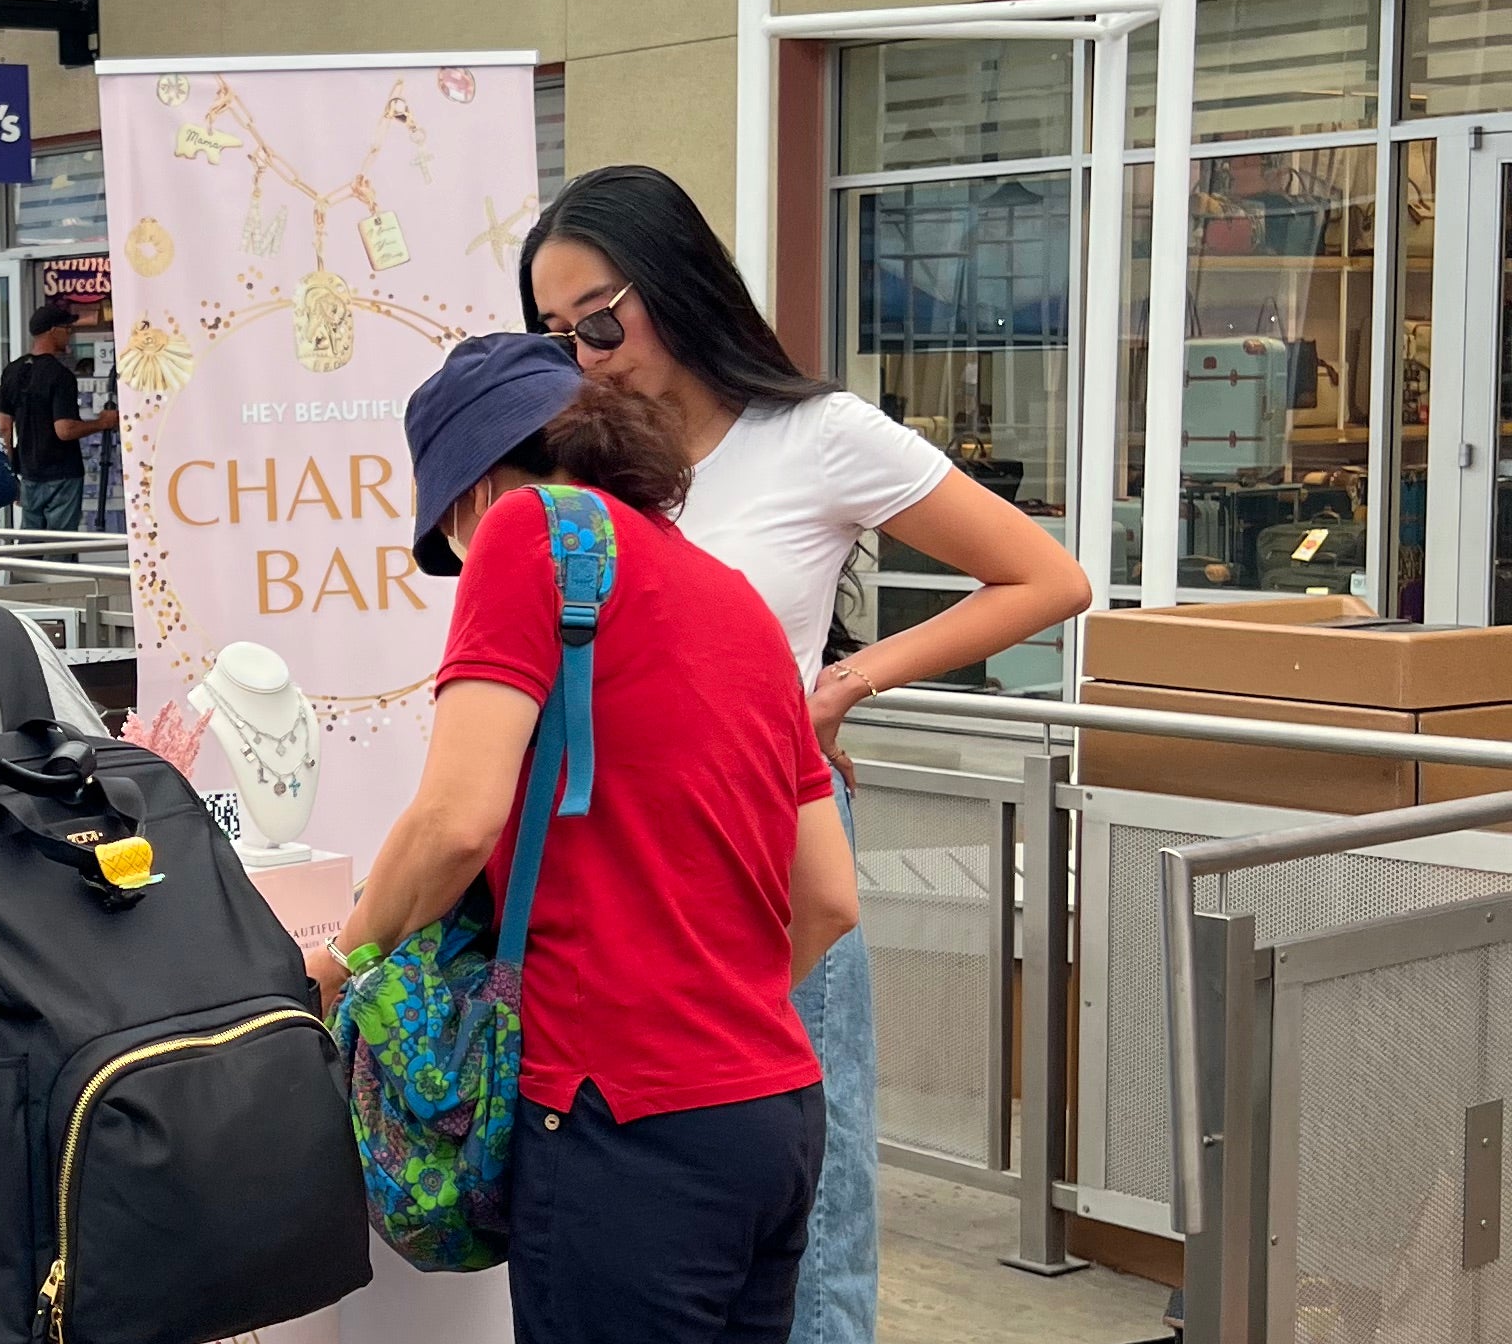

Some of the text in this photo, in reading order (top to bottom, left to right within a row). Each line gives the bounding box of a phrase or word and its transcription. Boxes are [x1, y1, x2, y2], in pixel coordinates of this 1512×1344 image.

[44, 270, 112, 296] Sweets
[241, 398, 405, 426] HEY BEAUTIFU
[167, 454, 416, 526] CHAR
[255, 545, 428, 615] BAR
[289, 920, 342, 938] AUTIFUL
